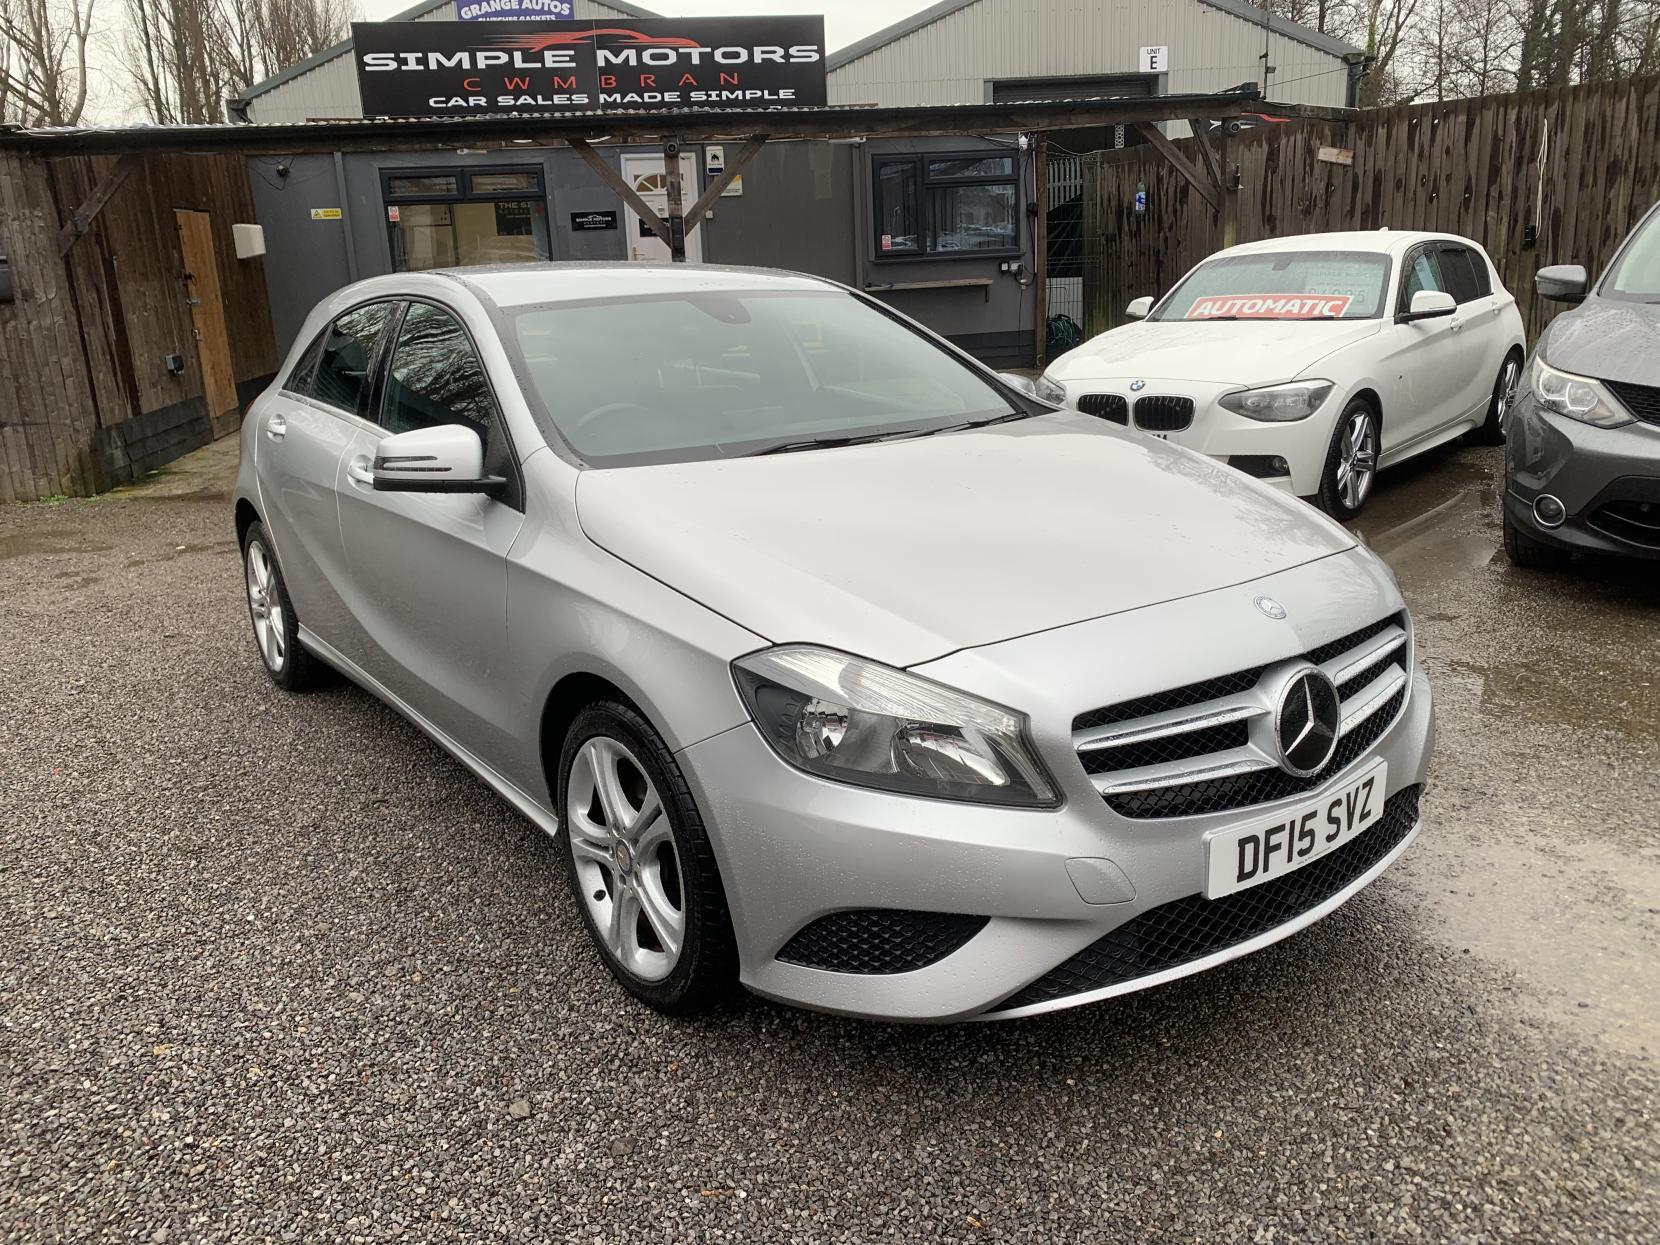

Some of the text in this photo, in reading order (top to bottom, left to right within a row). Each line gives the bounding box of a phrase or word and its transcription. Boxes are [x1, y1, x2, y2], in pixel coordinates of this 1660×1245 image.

[460, 0, 571, 19] GRANGE AUTOS
[363, 45, 820, 71] SIMPLE MOTORS
[1150, 55, 1158, 70] E
[429, 89, 796, 107] CAR SALES MADE SIMPLE
[1192, 299, 1343, 317] AUTOMATIC
[1236, 775, 1375, 884] DF15 SVZ
